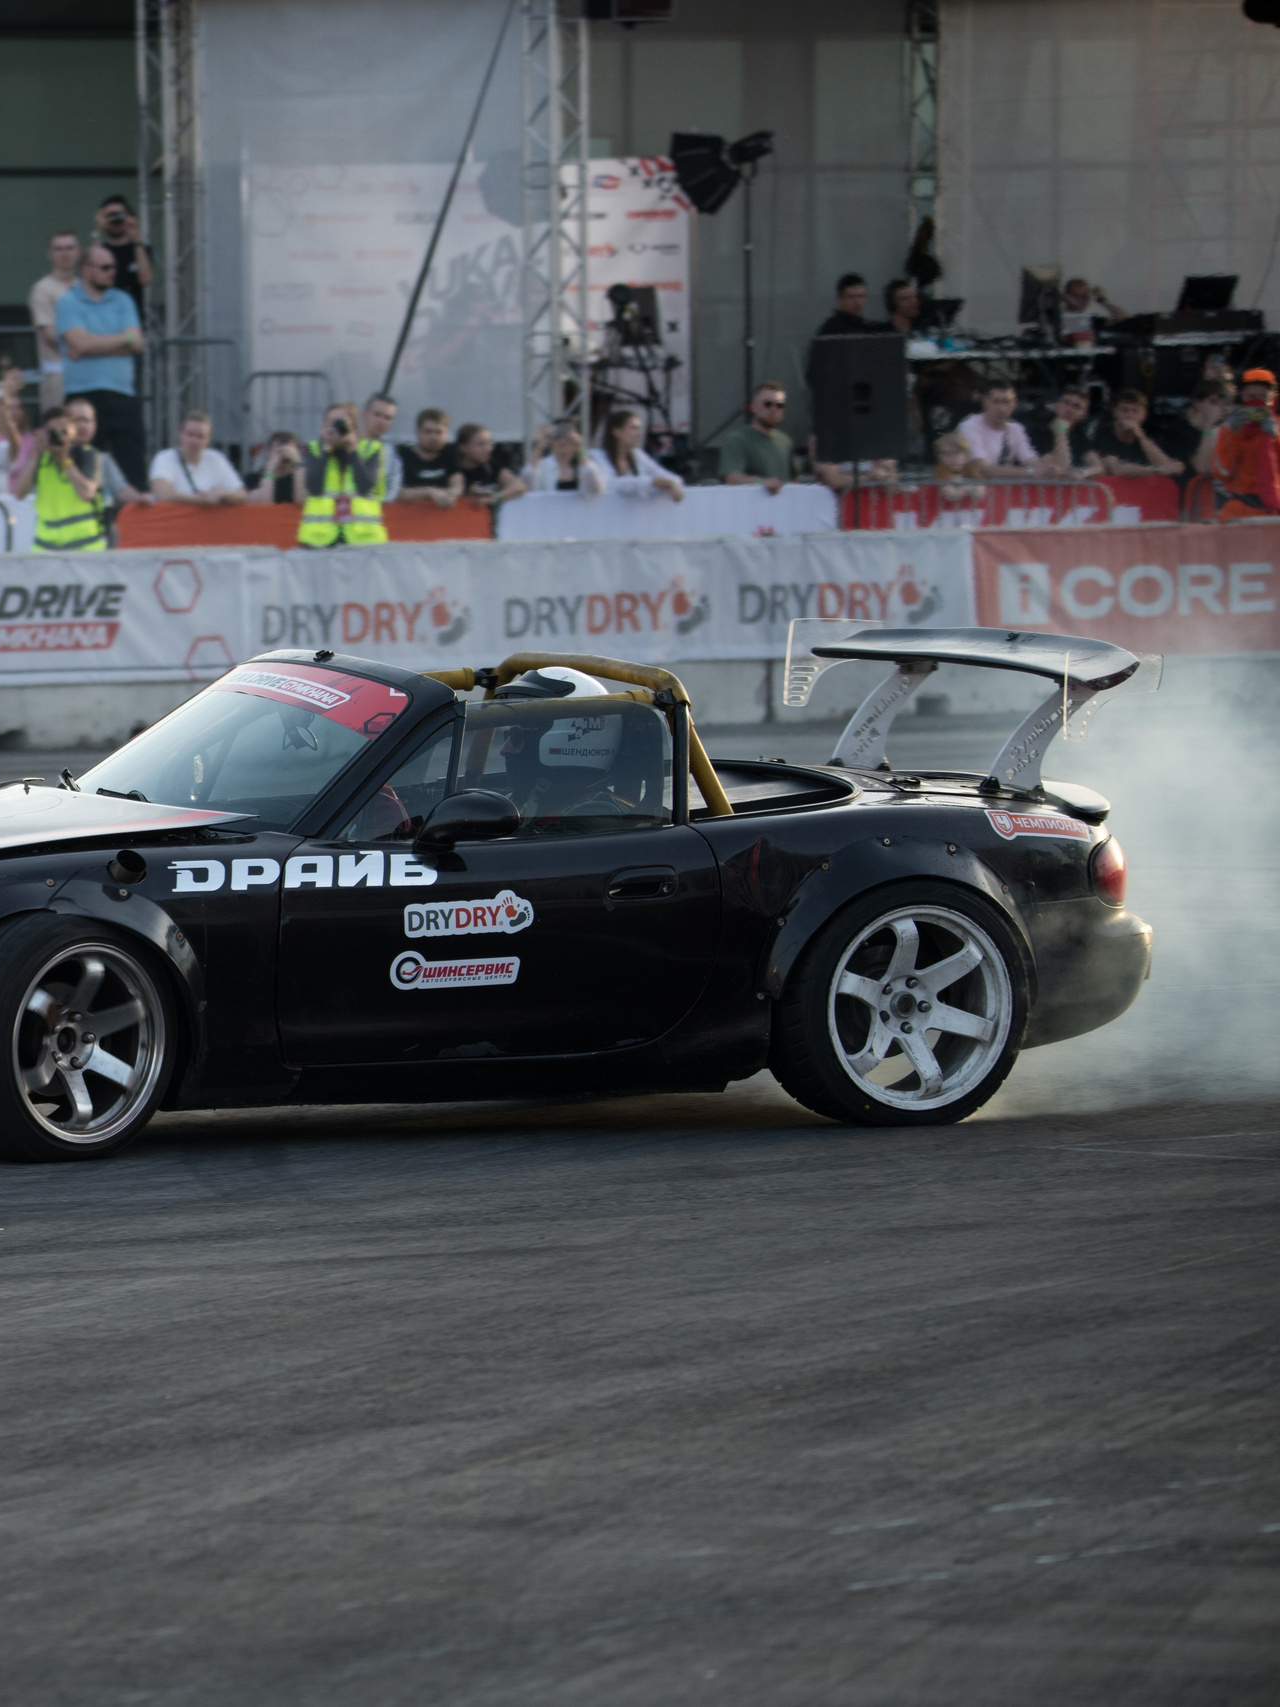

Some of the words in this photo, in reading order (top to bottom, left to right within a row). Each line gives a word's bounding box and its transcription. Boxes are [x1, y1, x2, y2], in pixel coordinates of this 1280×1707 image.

[503, 590, 666, 640] DRYDRY
[737, 579, 891, 625] DRYDRY
[260, 601, 425, 646] DRYDRY
[408, 905, 502, 932] DRYDRY
[421, 975, 481, 984] АВТОСЕРВИСНЫЕ
[484, 973, 513, 981] ЦЕНТРЫ
[422, 962, 515, 979] ШИНСЕРВИС
